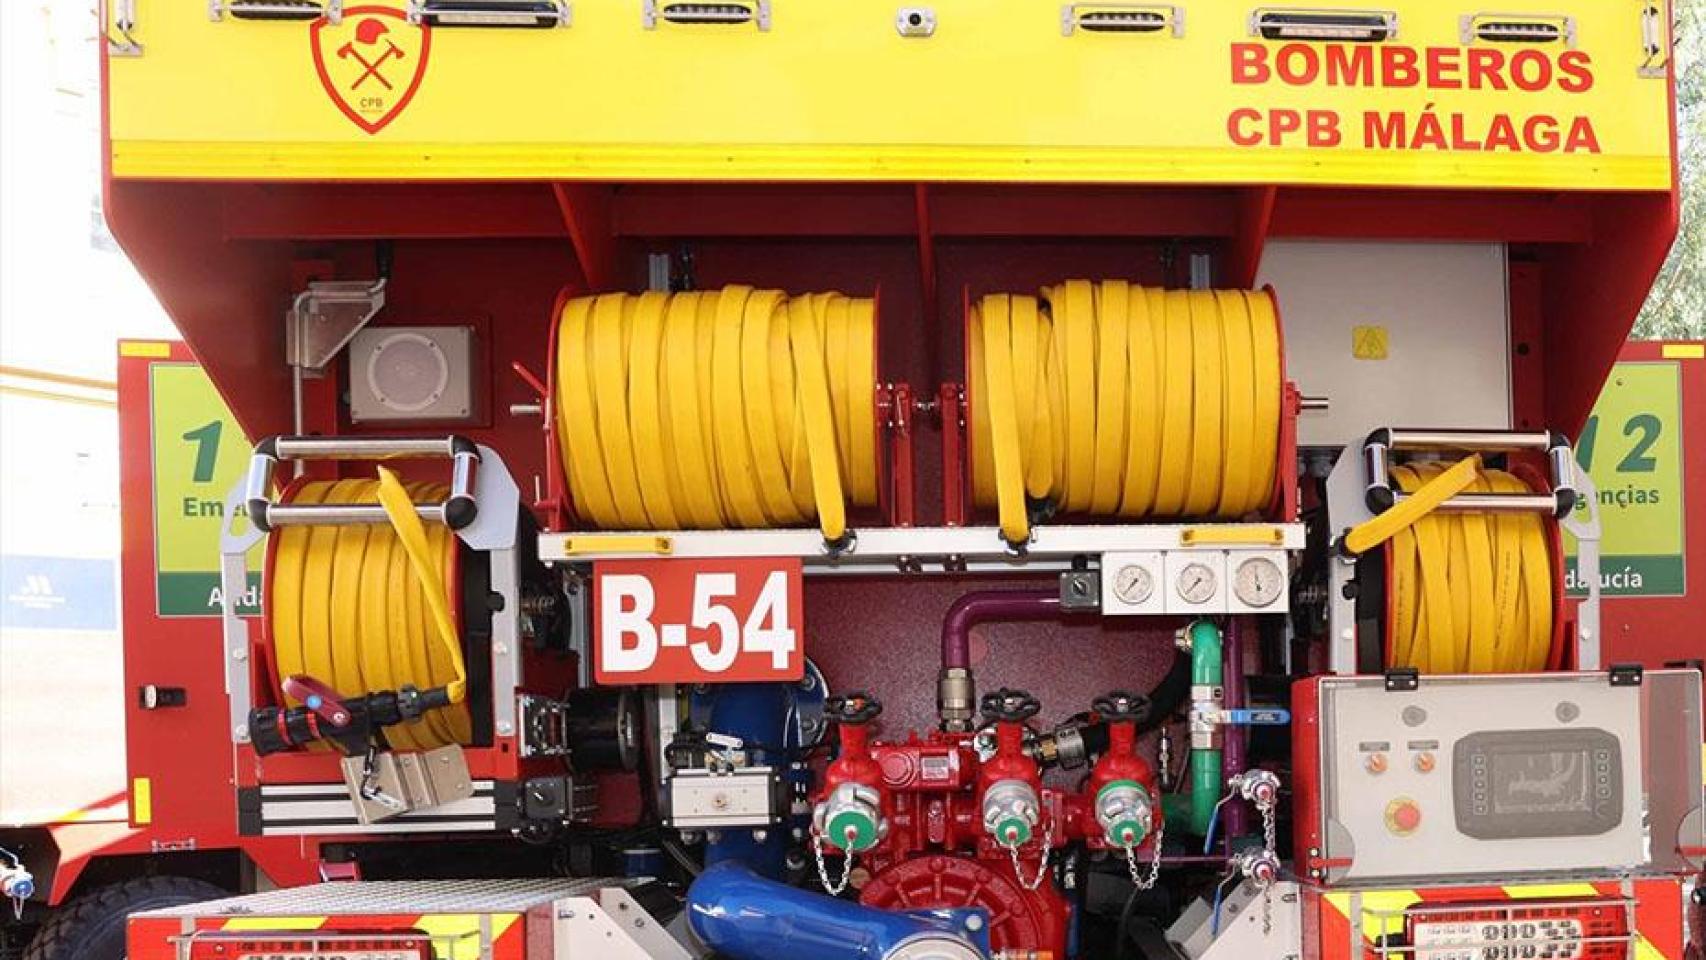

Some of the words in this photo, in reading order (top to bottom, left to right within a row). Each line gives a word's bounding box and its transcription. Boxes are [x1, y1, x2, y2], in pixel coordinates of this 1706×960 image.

[1230, 42, 1594, 93] BOMBEROS
[1226, 108, 1342, 147] CPB
[1363, 103, 1601, 154] MÁLAGA
[183, 420, 222, 482] 1
[602, 571, 795, 673] B-54
